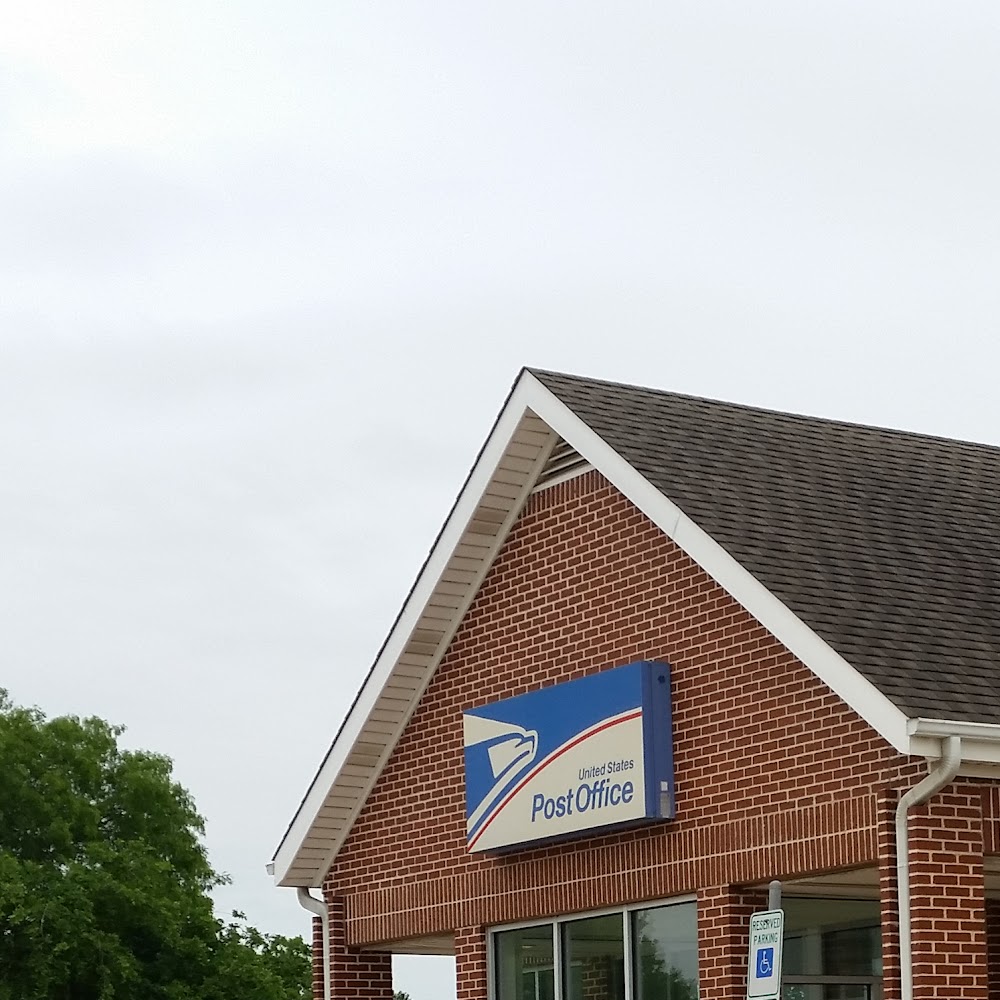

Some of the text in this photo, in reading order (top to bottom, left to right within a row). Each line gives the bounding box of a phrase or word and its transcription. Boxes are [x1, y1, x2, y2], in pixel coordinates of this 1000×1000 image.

[578, 759, 634, 780] United States
[531, 778, 633, 822] Post Office
[752, 917, 780, 931] RESERVED
[753, 932, 778, 945] PARKING
